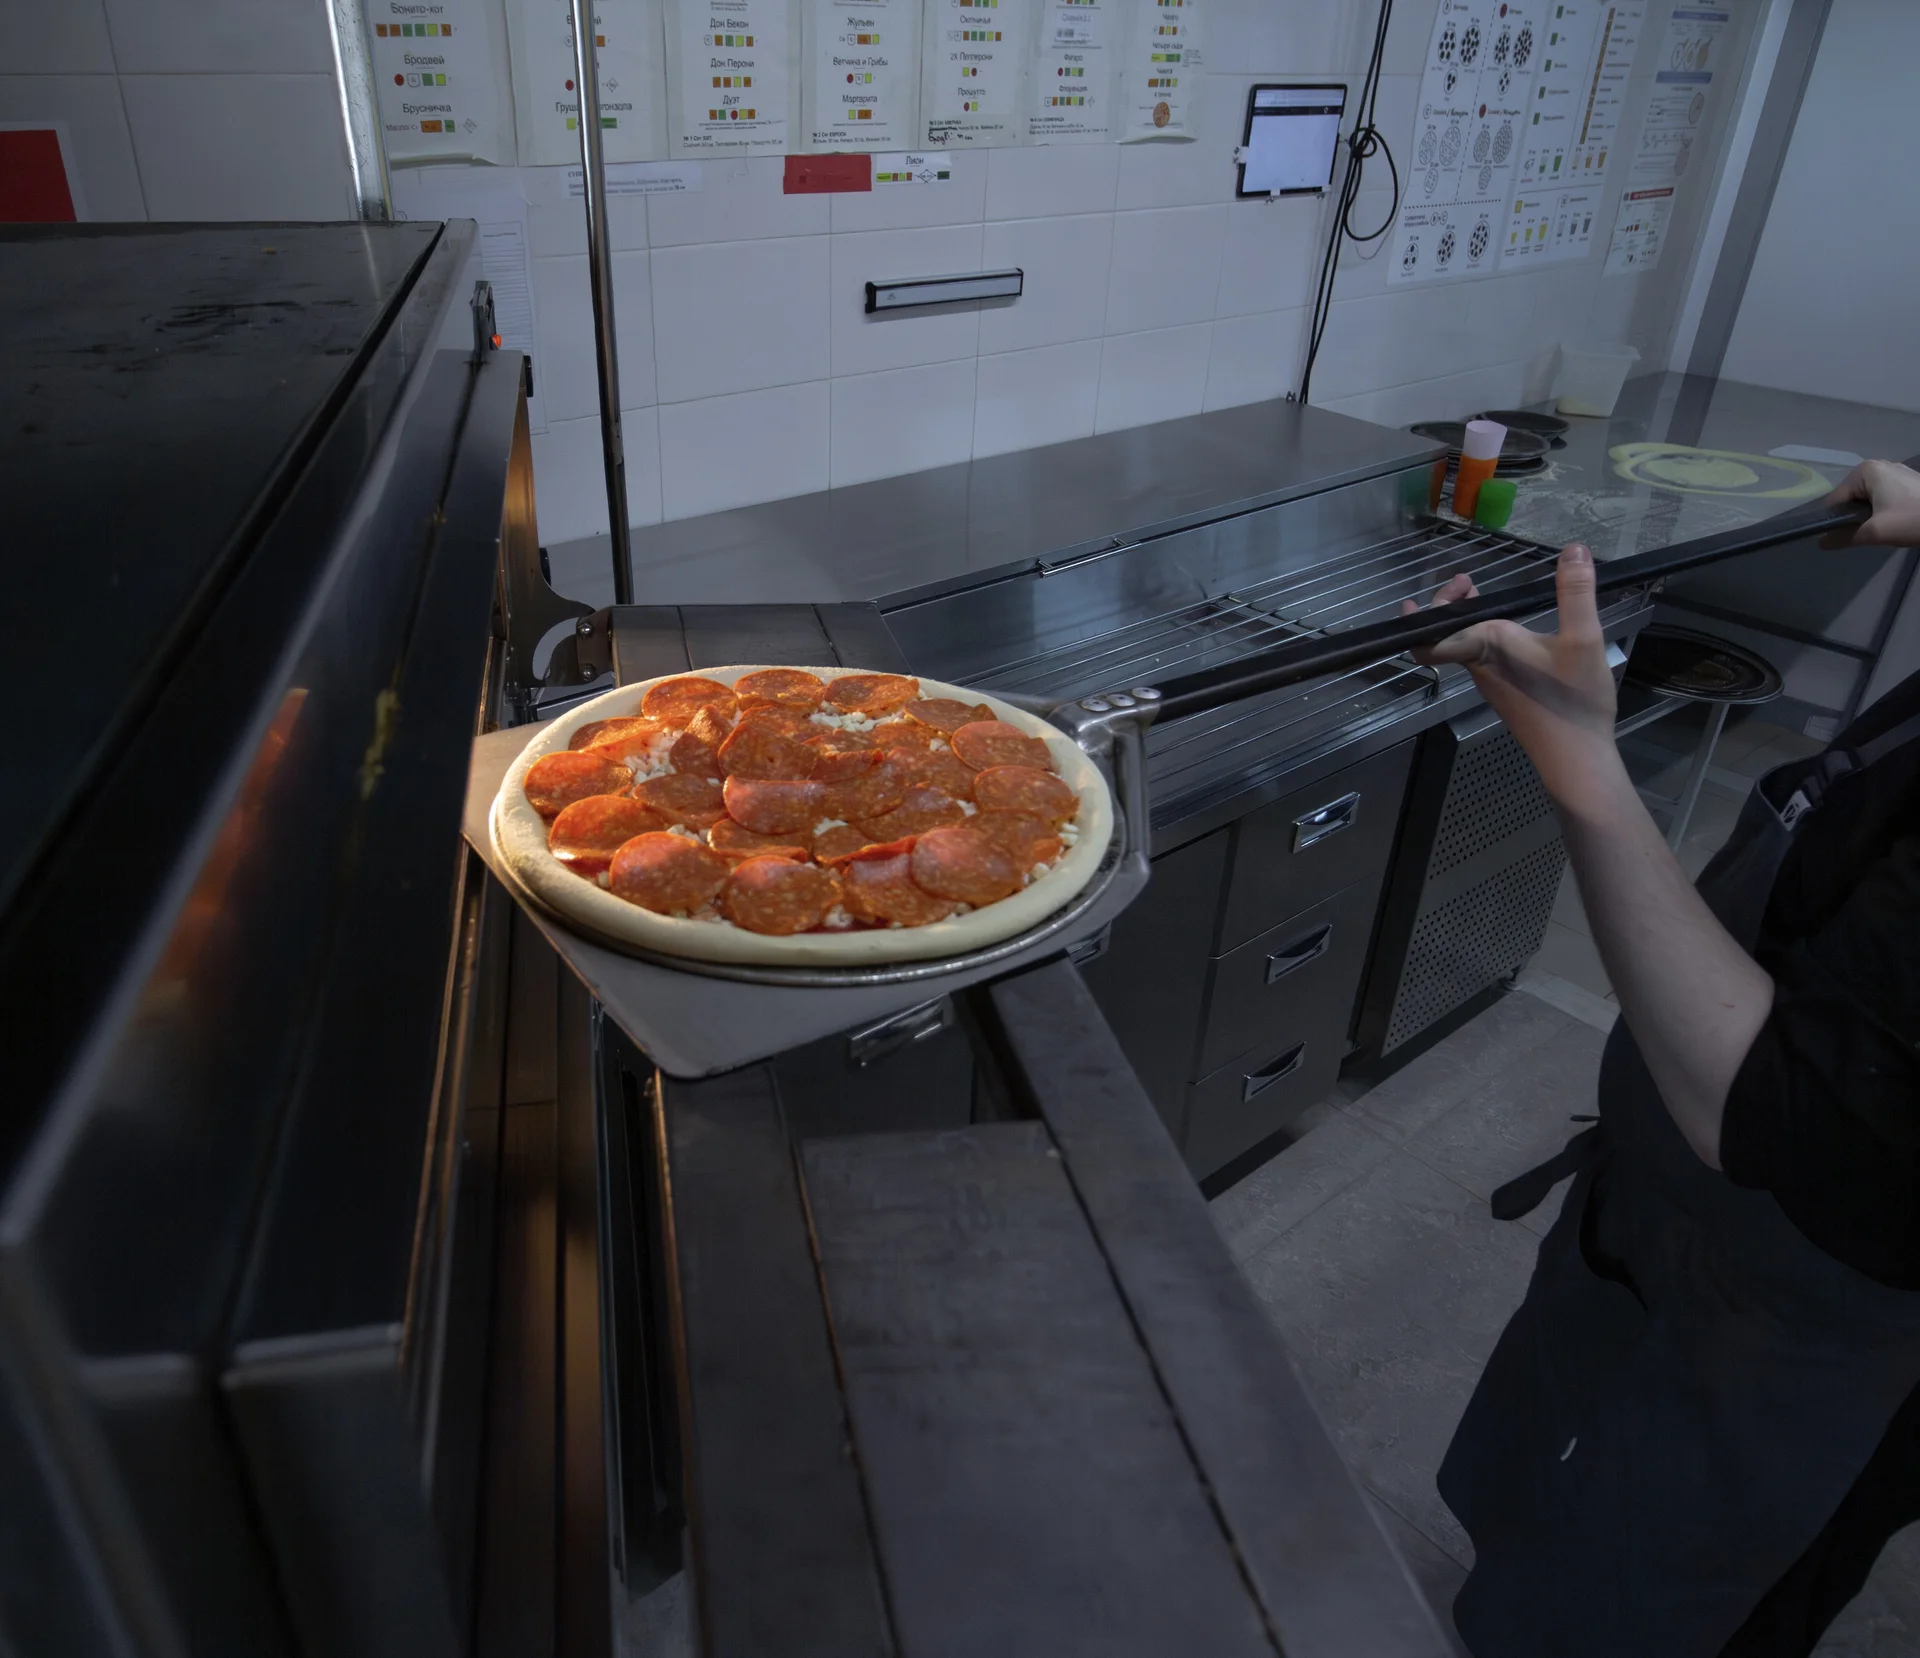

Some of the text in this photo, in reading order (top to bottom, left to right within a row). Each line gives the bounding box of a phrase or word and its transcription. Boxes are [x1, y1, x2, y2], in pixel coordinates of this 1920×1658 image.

[710, 18, 749, 29] Дон Бекон
[847, 17, 875, 28] Жульен
[404, 54, 445, 66] Бродвей
[833, 57, 860, 66] Ветчина
[868, 57, 888, 68] Грибы
[960, 52, 994, 62] Пепперони
[711, 58, 755, 70] Дон Перони
[958, 88, 986, 97] Прошутто
[722, 95, 740, 105] Дуэт
[842, 95, 878, 105] Маргарита
[402, 103, 452, 115] Брусничка
[905, 155, 925, 165] Лион
